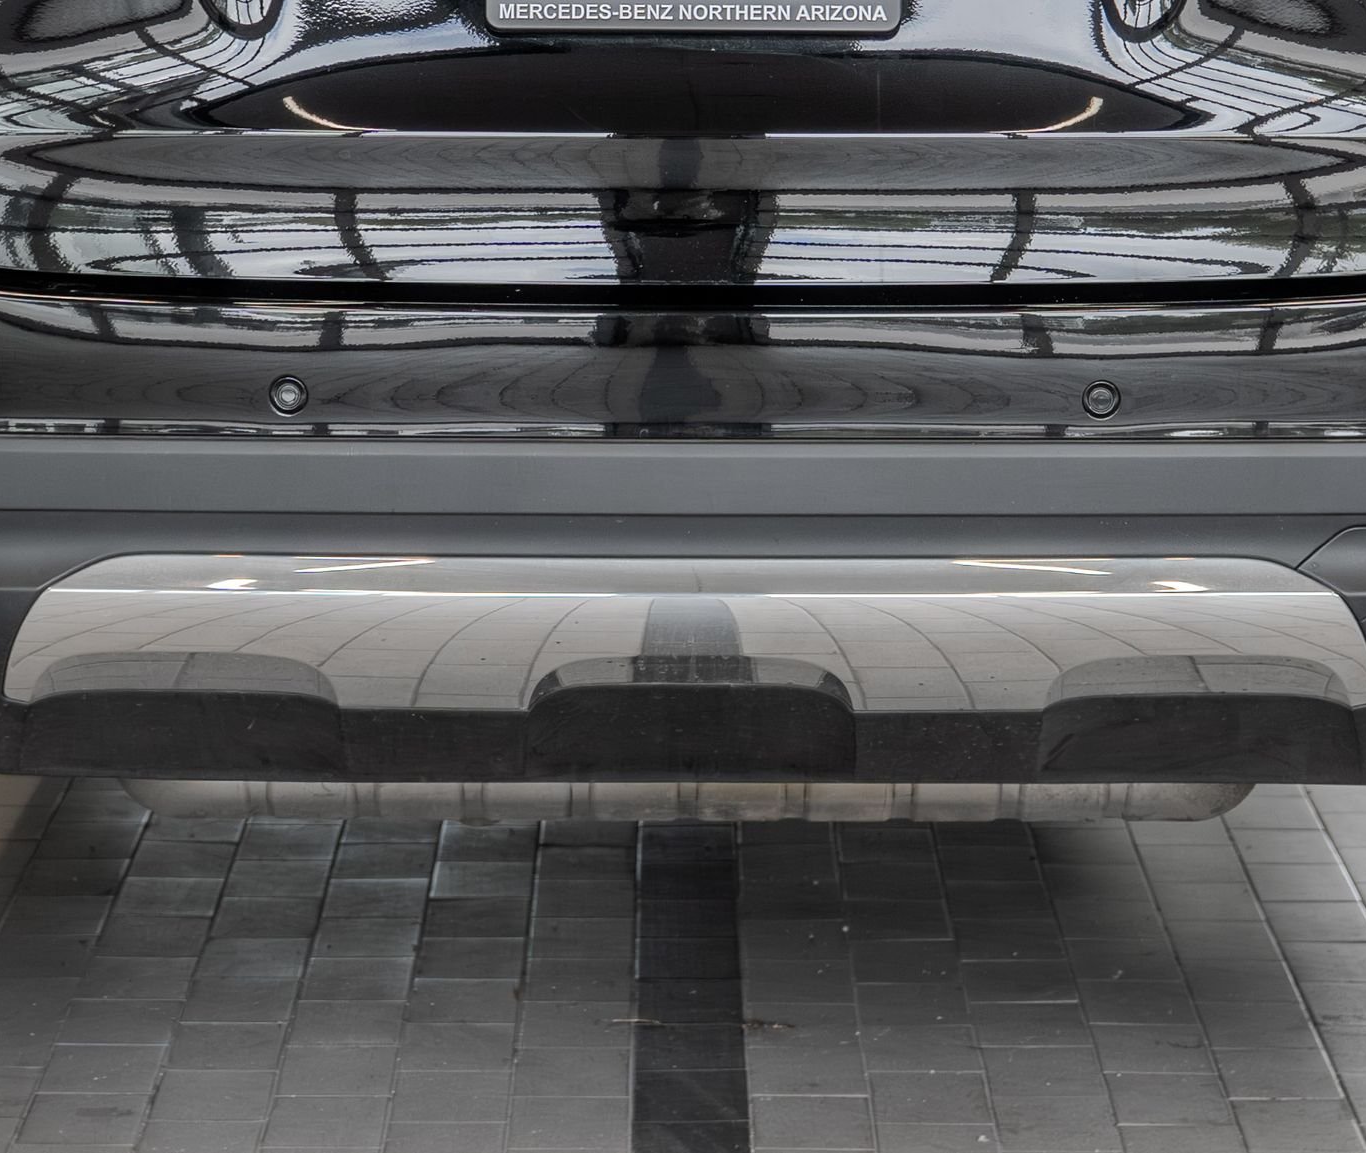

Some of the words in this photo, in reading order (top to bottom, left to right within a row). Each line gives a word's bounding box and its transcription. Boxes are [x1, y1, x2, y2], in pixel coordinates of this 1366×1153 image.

[499, 3, 673, 21] MERCEDES-BENZ
[679, 4, 791, 21] NORTHERN
[795, 4, 887, 22] ARIZONA
